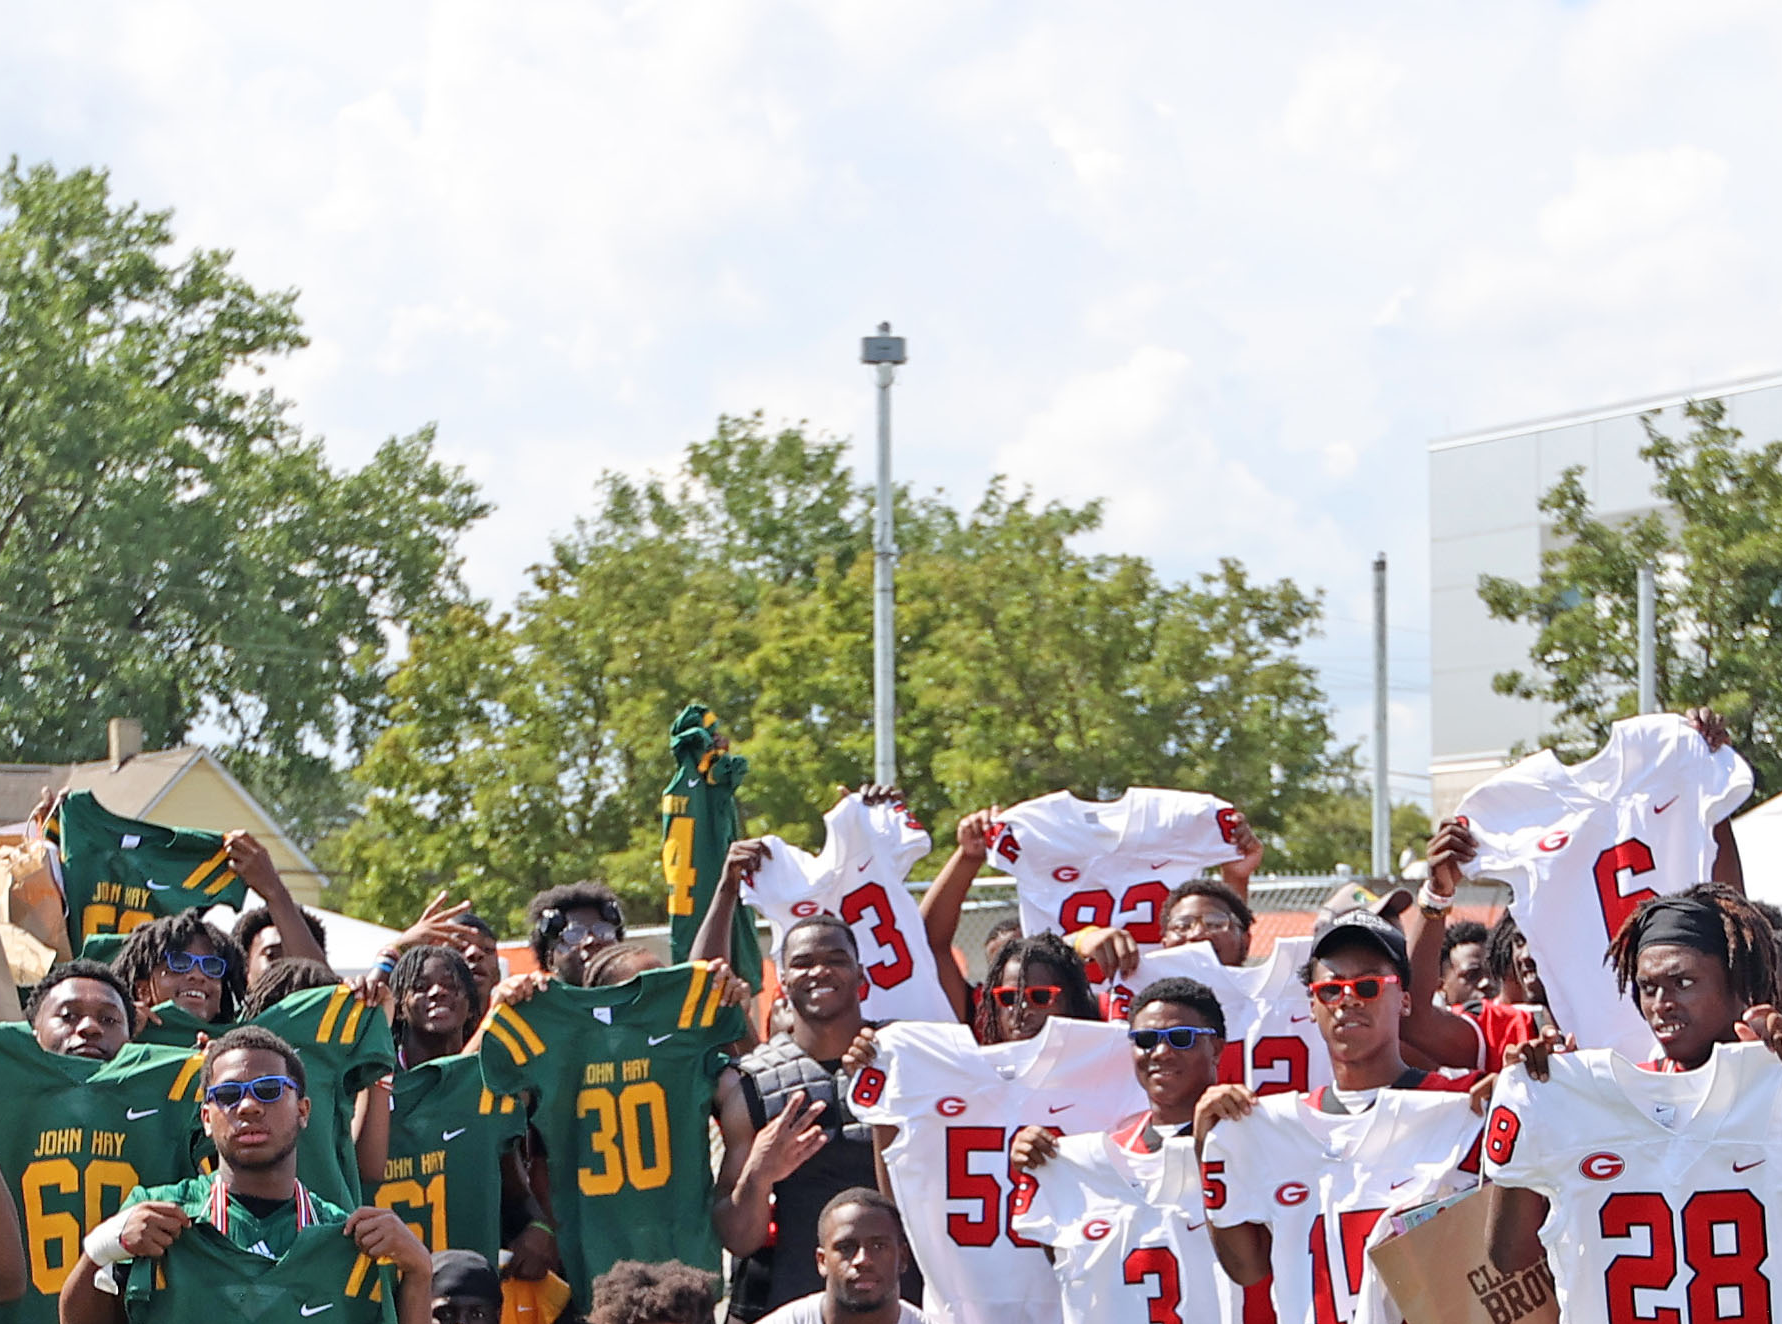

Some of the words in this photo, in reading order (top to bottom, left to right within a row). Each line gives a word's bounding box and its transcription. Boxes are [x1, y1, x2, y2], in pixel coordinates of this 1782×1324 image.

[663, 817, 697, 916] 4
[1051, 866, 1080, 883] G
[1593, 837, 1661, 943] 6
[791, 901, 819, 918] G
[840, 881, 914, 991] 3
[586, 1062, 615, 1084] OHN
[622, 1058, 650, 1082] HAY
[851, 1067, 886, 1108] 8
[936, 1096, 967, 1117] G
[34, 1128, 83, 1157] JOHN
[91, 1130, 125, 1157] HAY
[576, 1081, 672, 1197] 30
[1485, 1105, 1521, 1165] 8
[384, 1157, 413, 1181] OHN
[421, 1151, 445, 1175] HAY
[1579, 1151, 1625, 1181] G
[1274, 1181, 1310, 1207] G
[22, 1158, 140, 1295] 60
[1082, 1219, 1112, 1241] G
